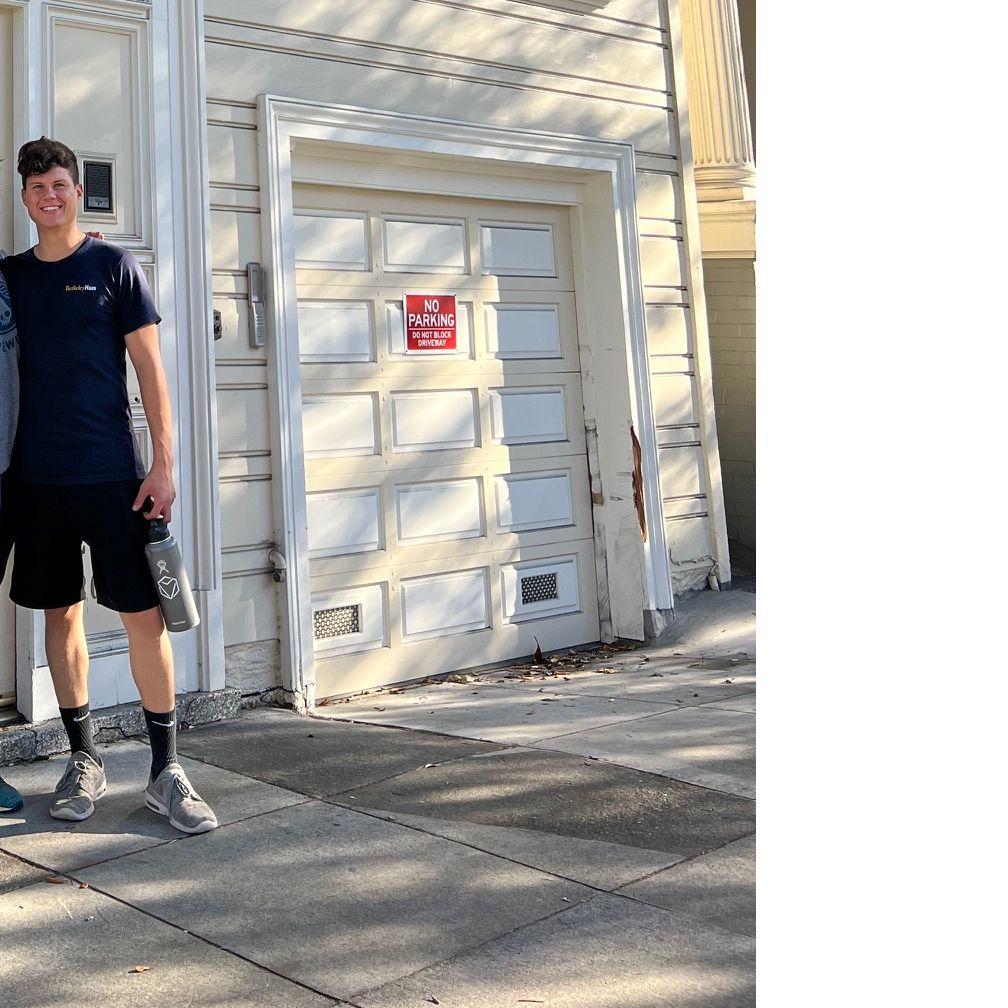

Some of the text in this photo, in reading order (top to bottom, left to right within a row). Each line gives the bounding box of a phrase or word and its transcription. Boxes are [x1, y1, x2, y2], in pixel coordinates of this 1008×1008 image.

[424, 299, 440, 313] NO
[408, 313, 455, 327] PARKING
[412, 331, 452, 339] DO NOT BLOCK
[417, 339, 447, 347] DRIVEWAY
